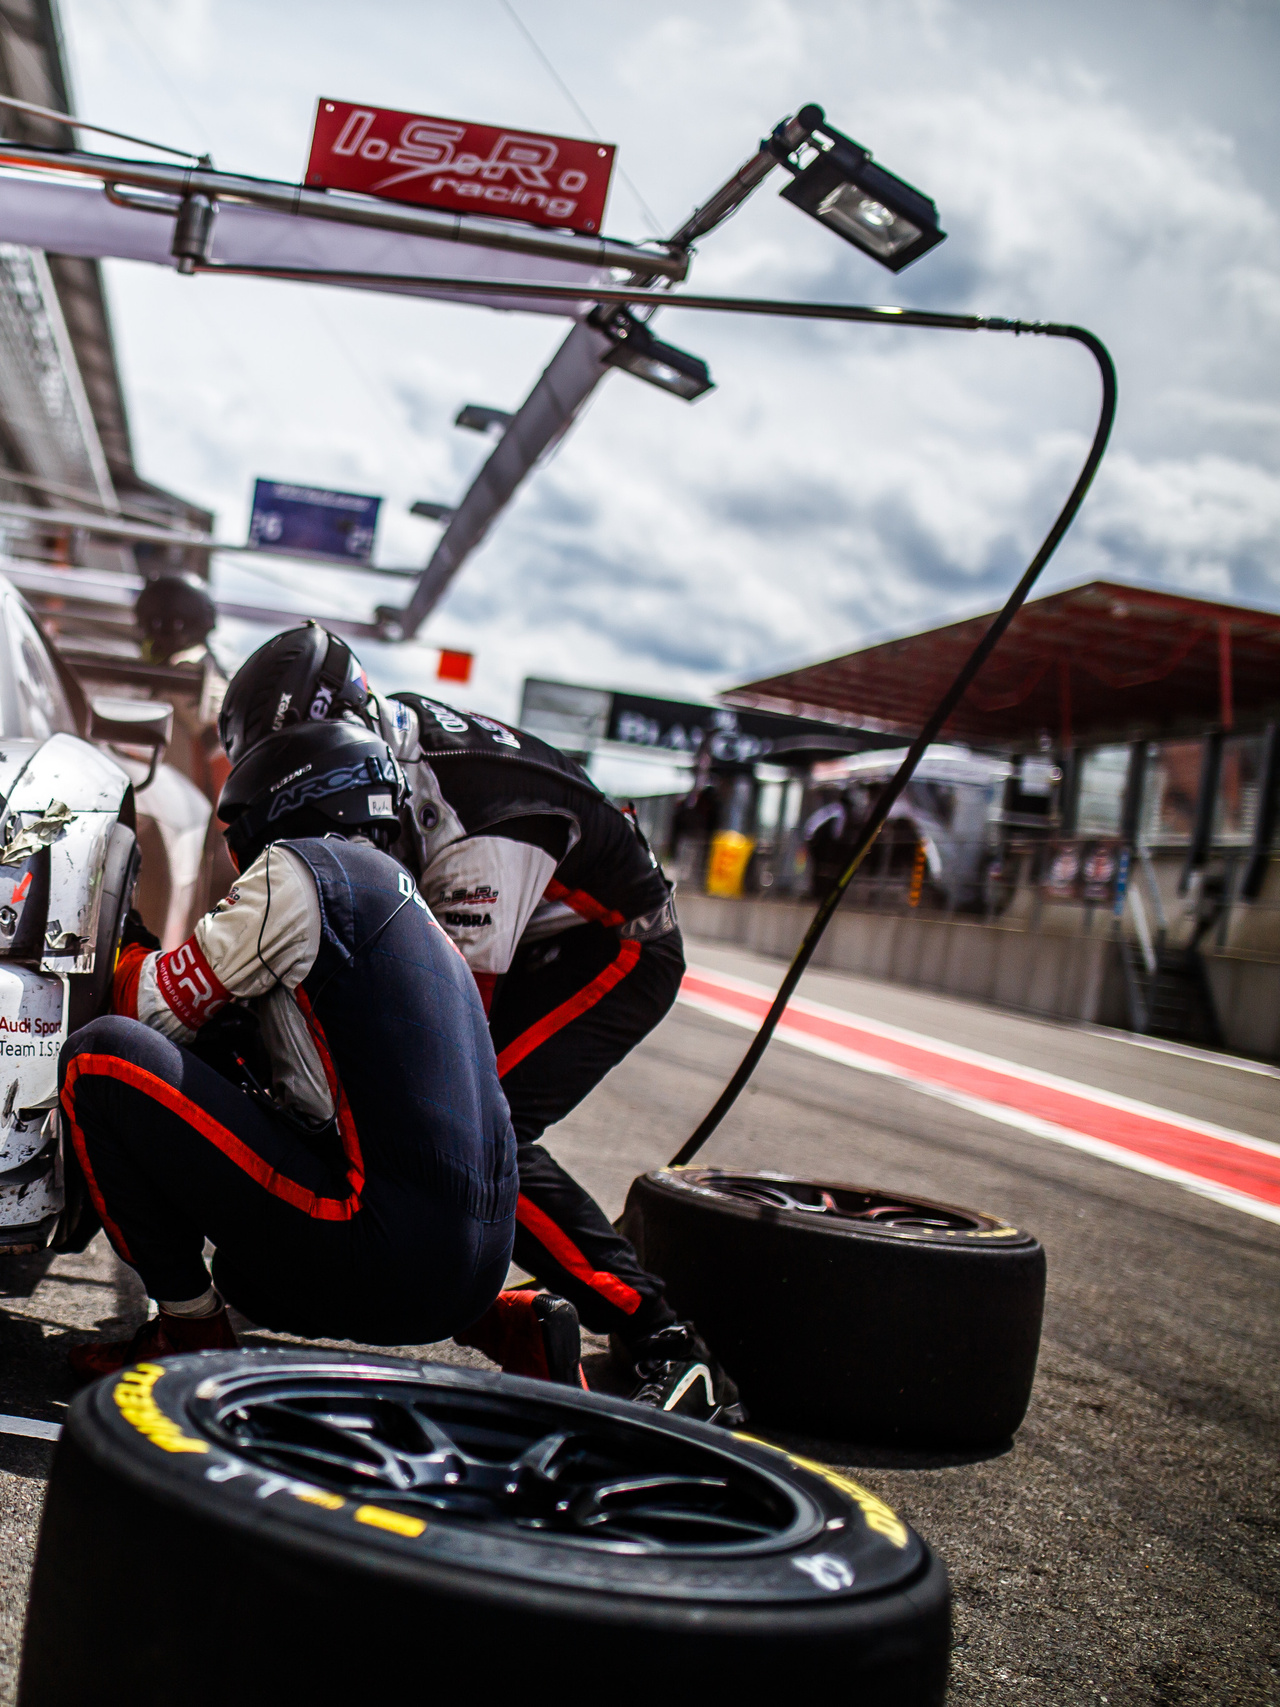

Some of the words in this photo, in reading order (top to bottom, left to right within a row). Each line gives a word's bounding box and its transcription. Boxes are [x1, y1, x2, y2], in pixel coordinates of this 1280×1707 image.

[431, 177, 578, 218] racing
[272, 692, 293, 731] uvex
[309, 686, 333, 720] ex
[445, 912, 492, 928] KOBRA
[159, 961, 191, 1018] MOTORSPORTS
